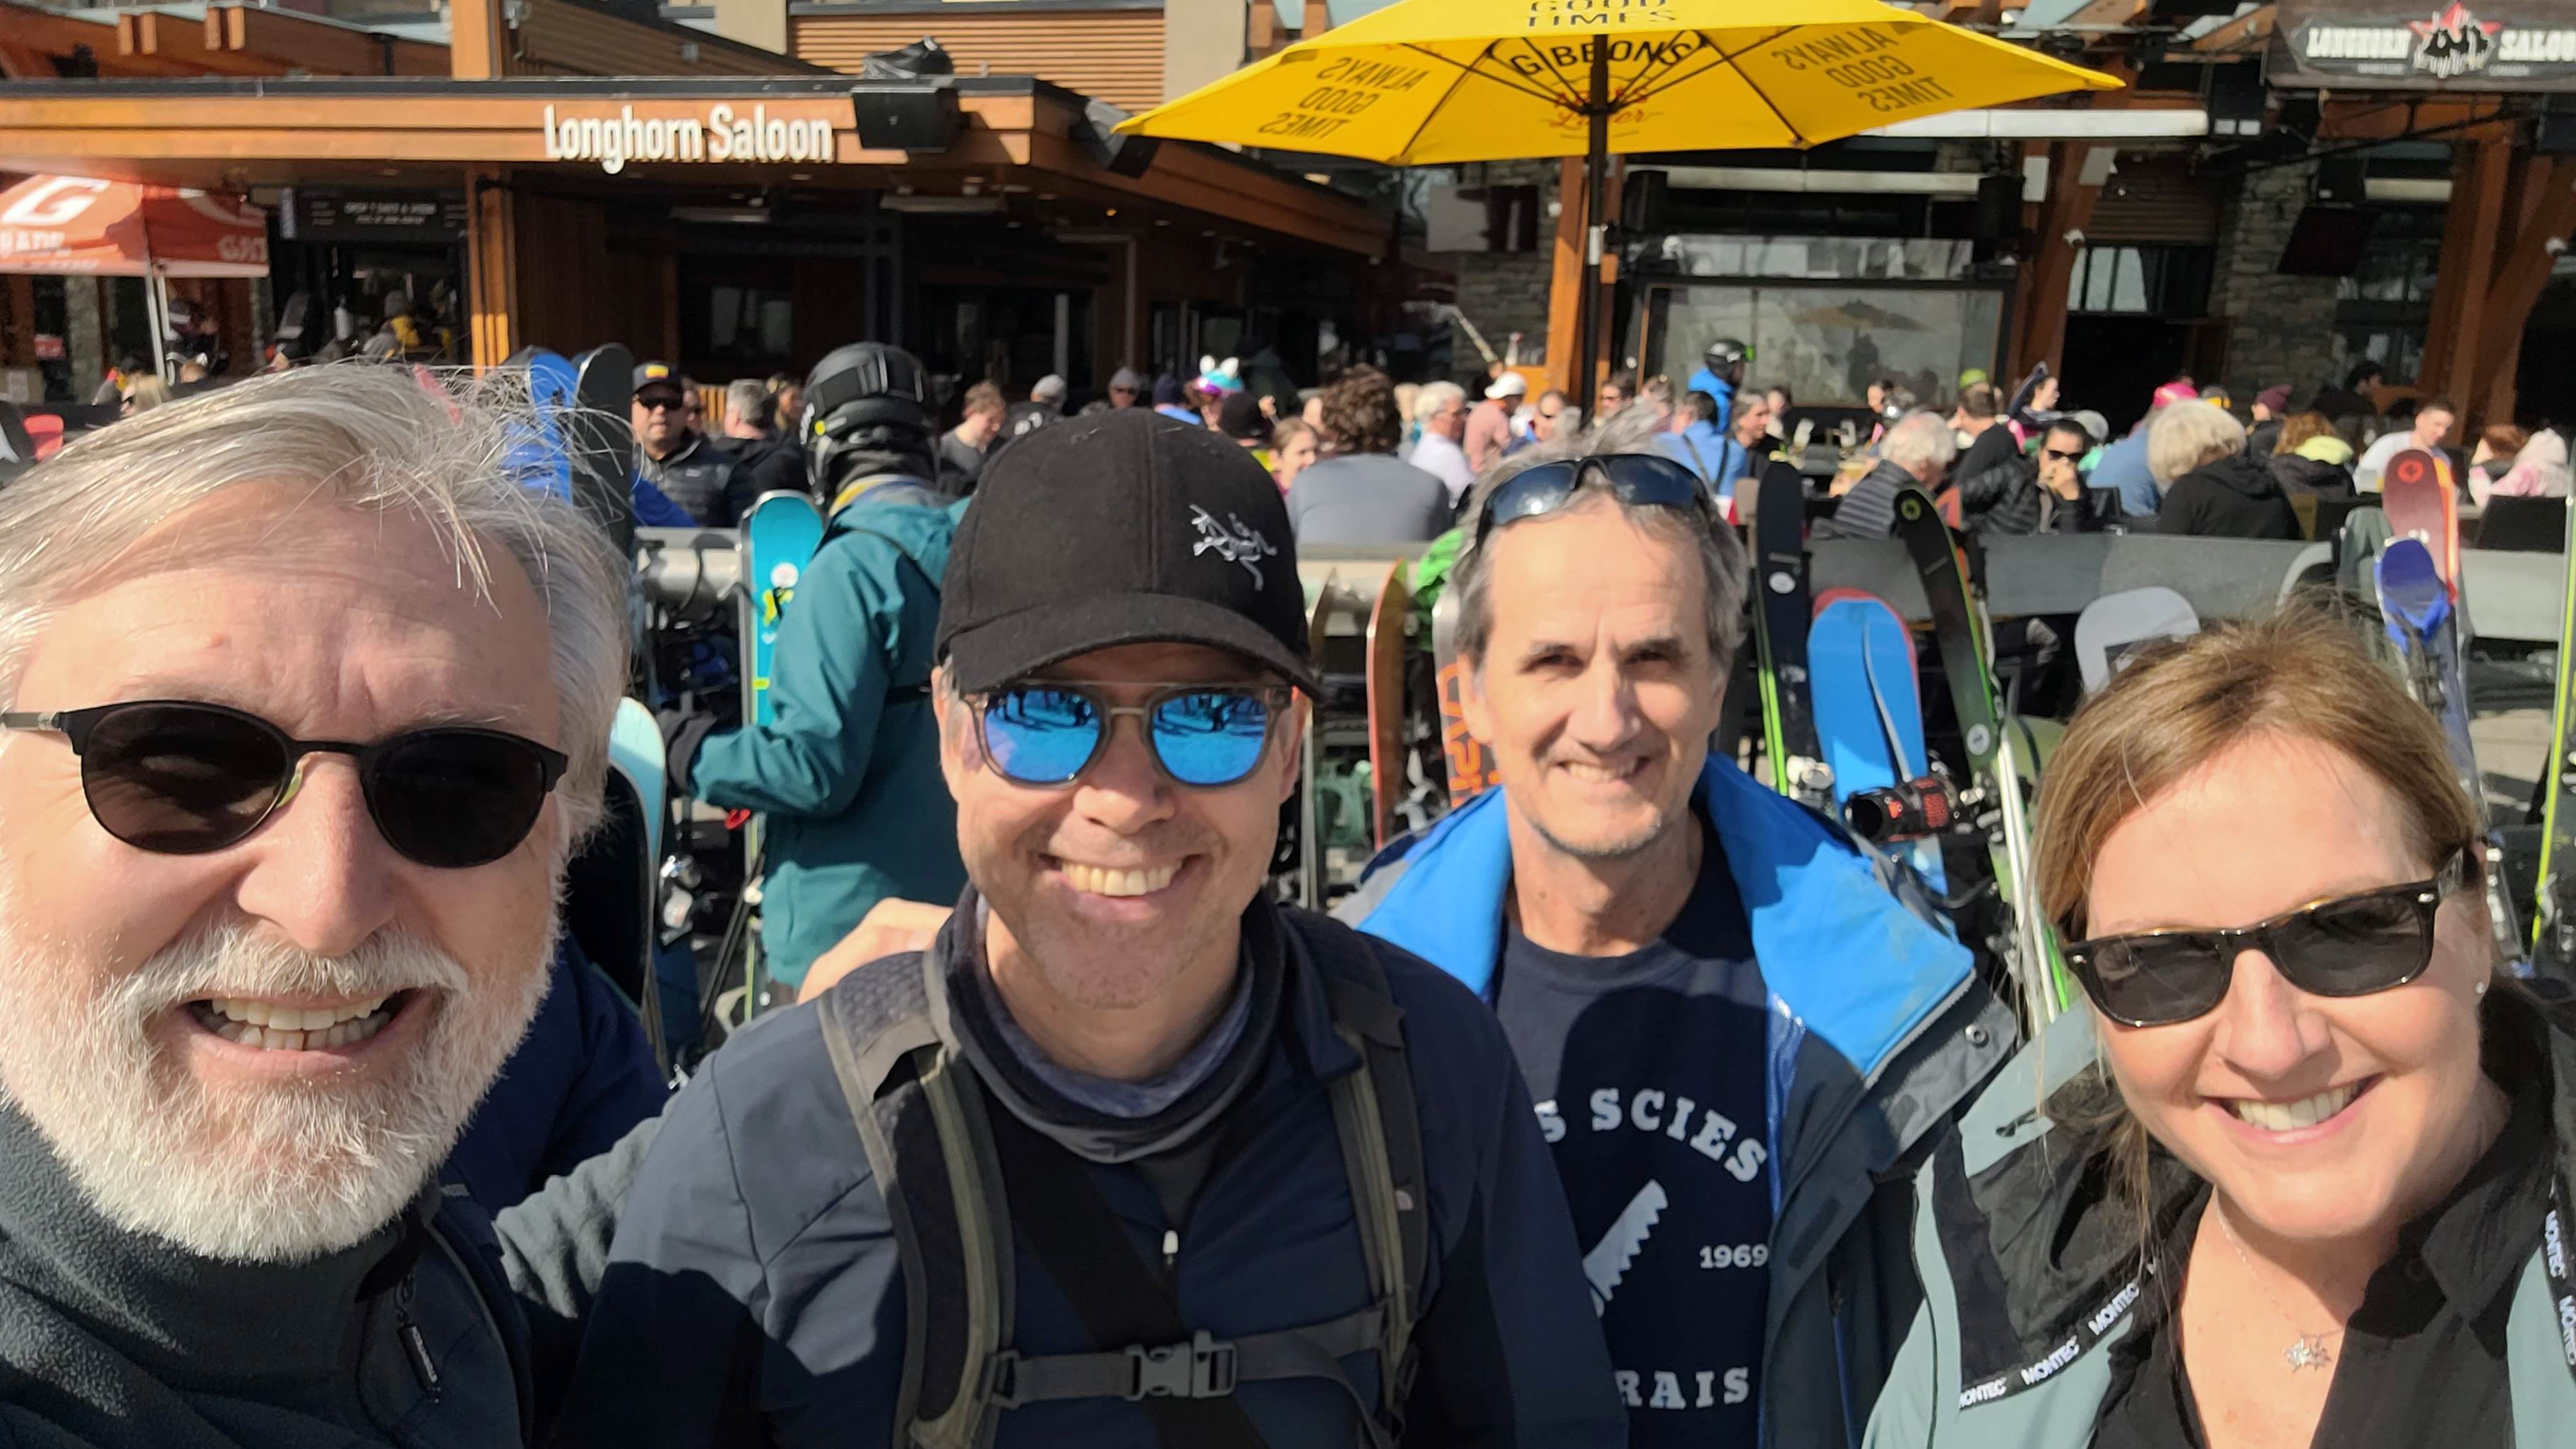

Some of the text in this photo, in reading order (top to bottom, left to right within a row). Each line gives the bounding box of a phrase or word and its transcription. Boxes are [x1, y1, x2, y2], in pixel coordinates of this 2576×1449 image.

[1527, 9, 1678, 27] TIMES
[544, 102, 834, 174] Longhorn Saloon
[1590, 1087, 1767, 1183] SCIES
[1698, 1244, 1769, 1269] 1969
[2088, 1282, 2140, 1335] MONTEC
[2020, 1335, 2080, 1385] MONTEC
[1615, 1367, 1751, 1410] RAIS
